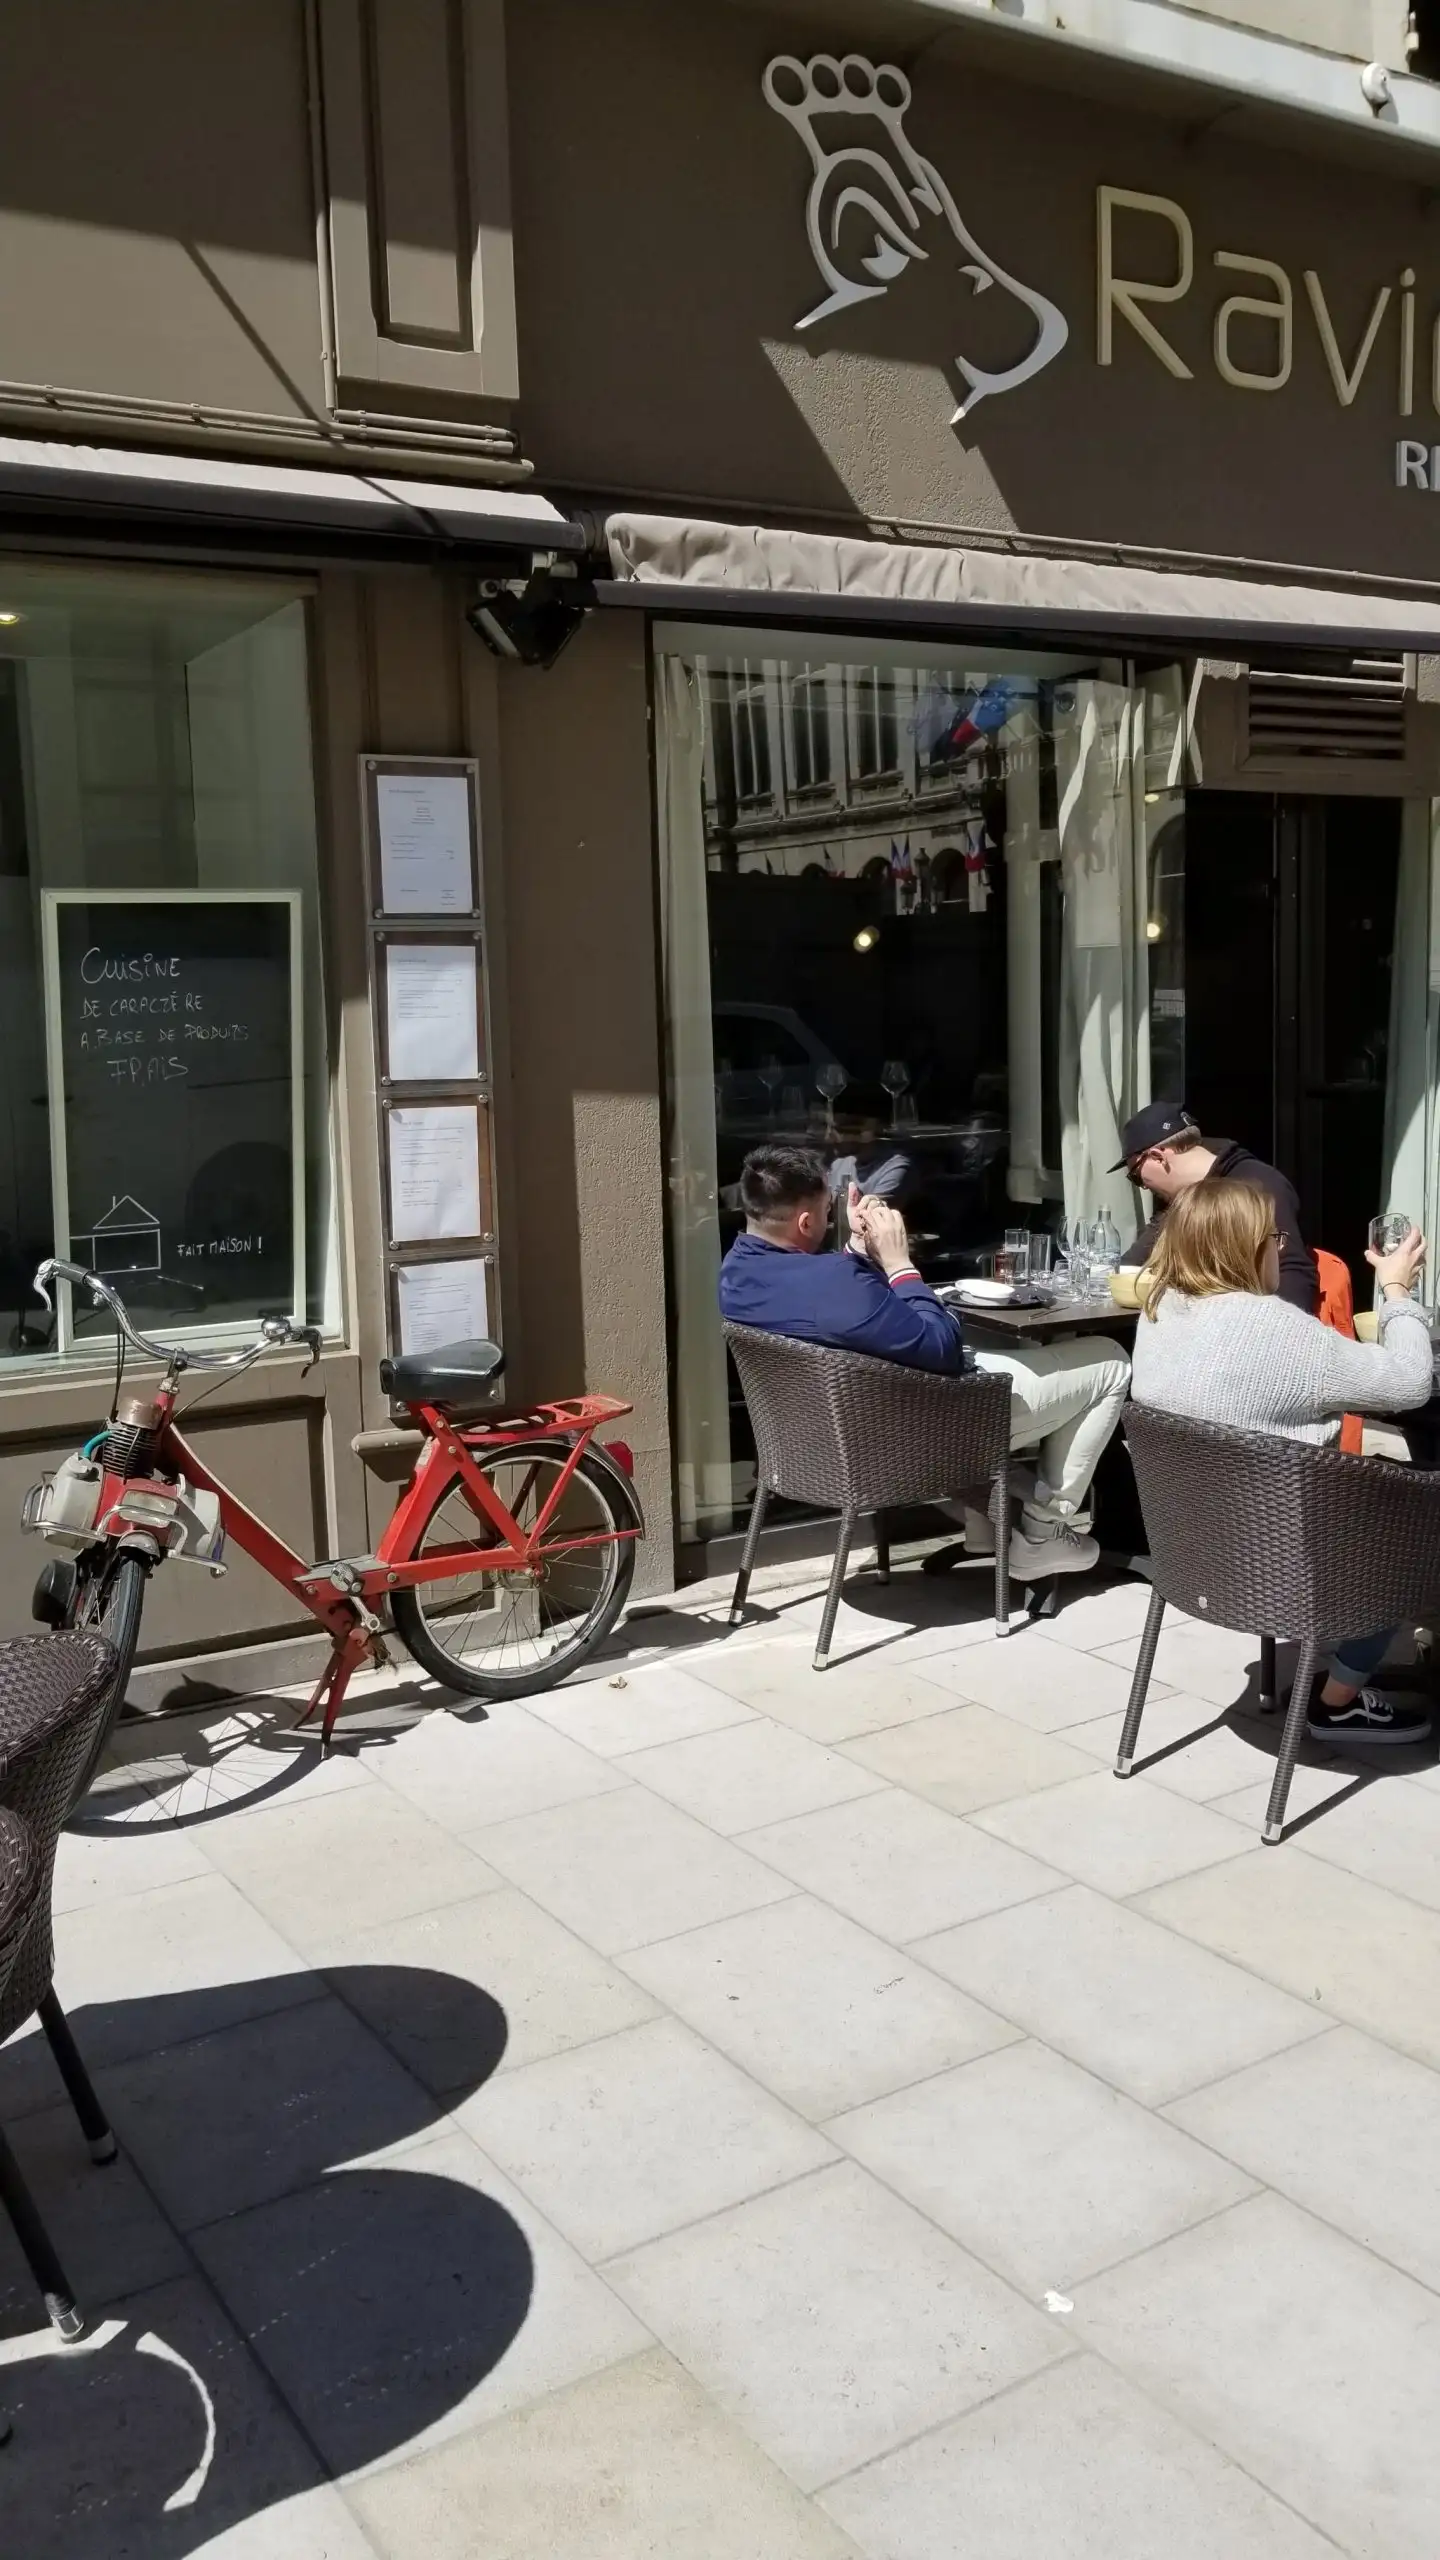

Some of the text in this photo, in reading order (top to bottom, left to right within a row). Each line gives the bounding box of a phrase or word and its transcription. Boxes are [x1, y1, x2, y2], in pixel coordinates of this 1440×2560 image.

[1096, 184, 1440, 417] Ravi
[80, 997, 102, 1019] DE
[96, 1028, 145, 1048] BASE
[158, 1028, 177, 1042] DE
[185, 1023, 249, 1041] PRODUITS
[107, 1056, 189, 1086] FRAIS
[177, 1243, 205, 1256] FAIT
[209, 1234, 252, 1254] MAISON
